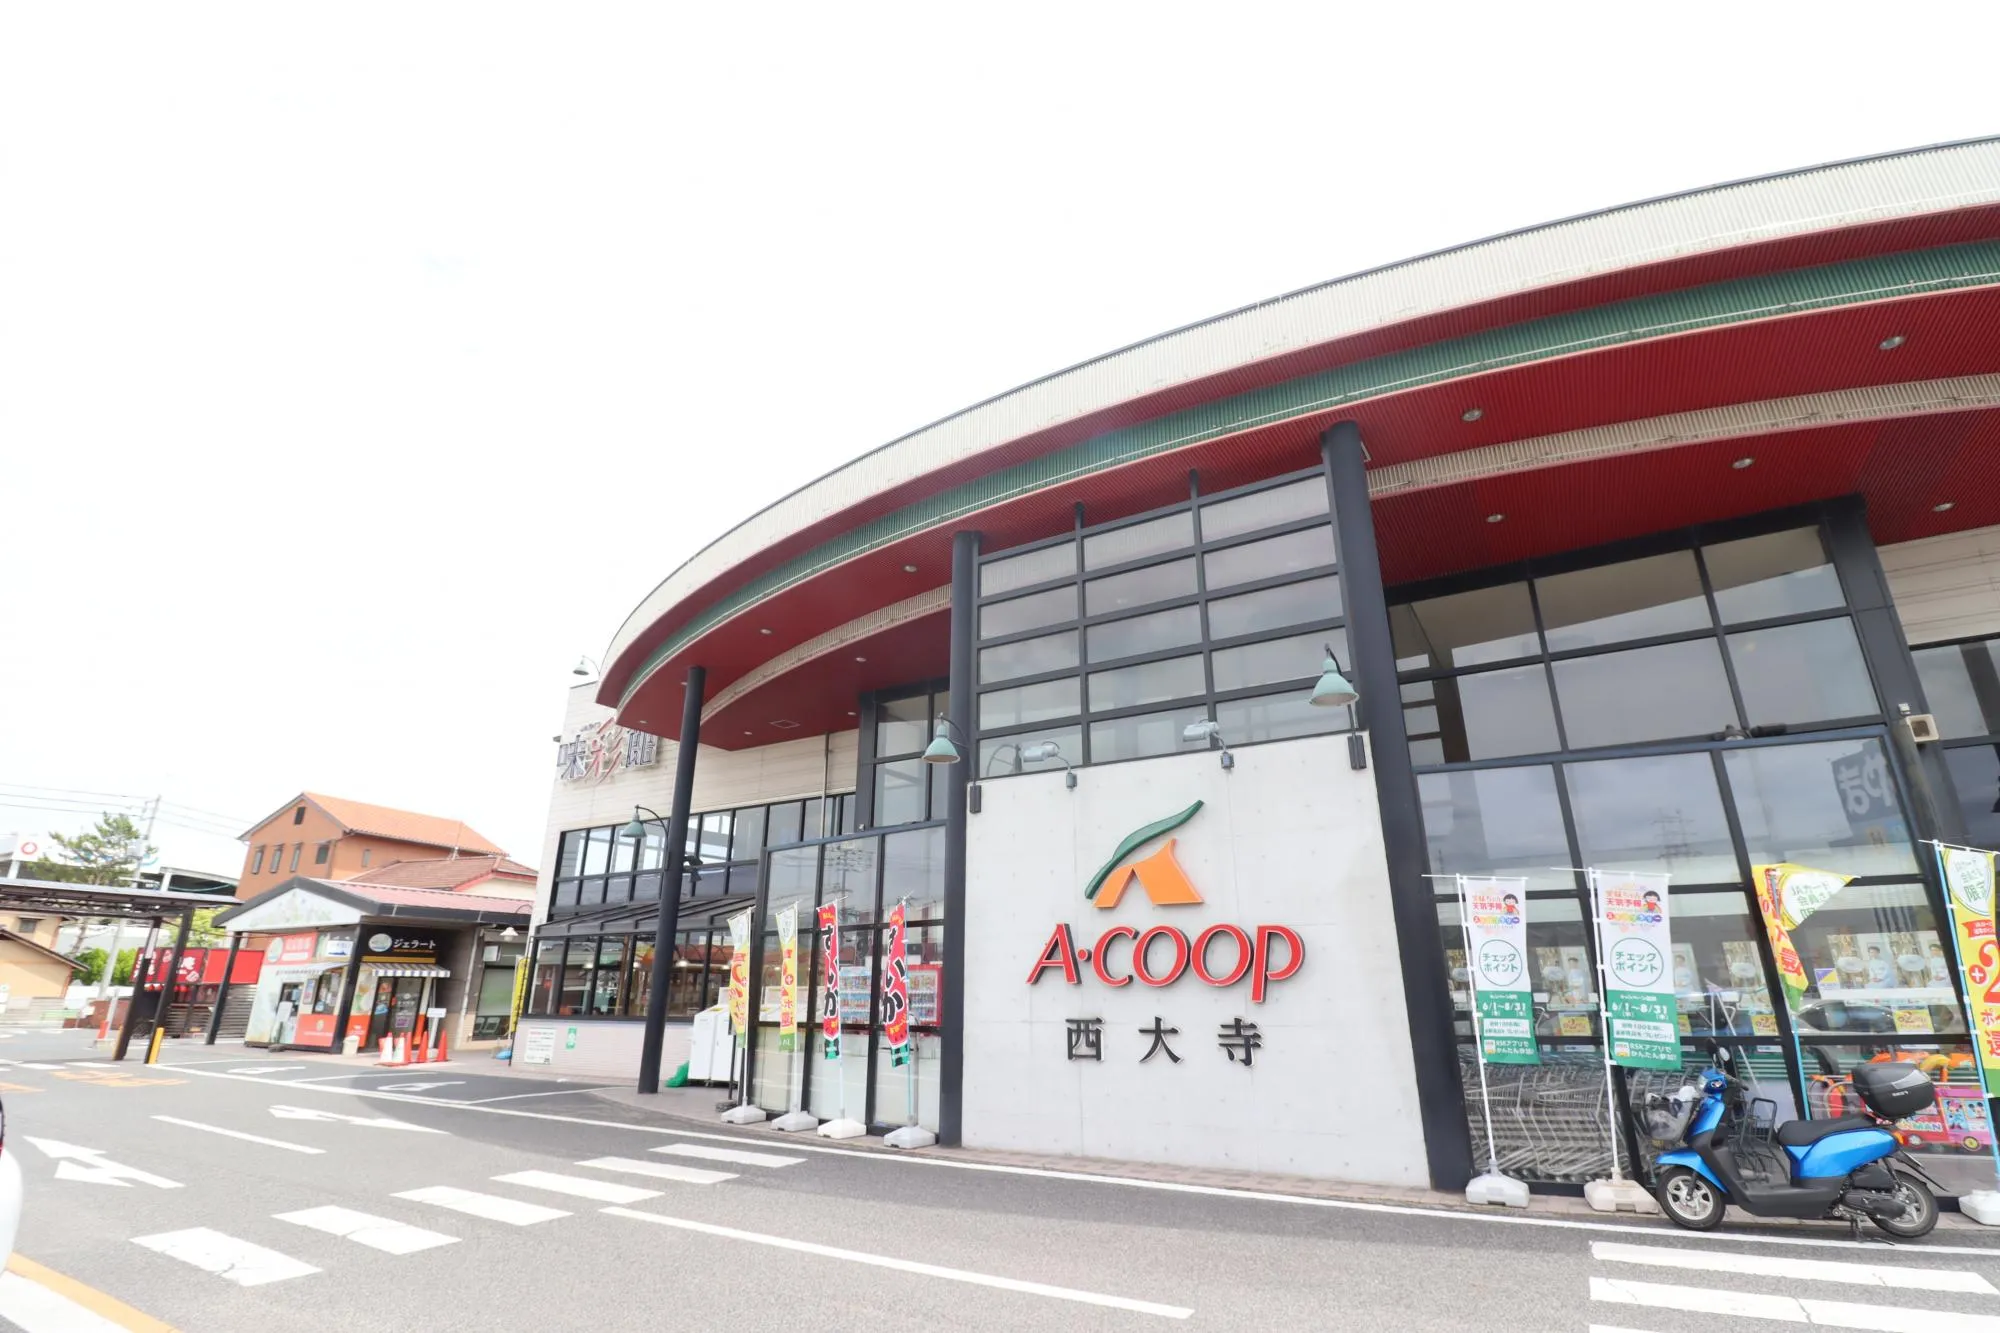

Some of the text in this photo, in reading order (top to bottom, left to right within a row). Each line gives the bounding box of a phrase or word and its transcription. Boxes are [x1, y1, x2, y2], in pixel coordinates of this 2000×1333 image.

[394, 939, 436, 949] ジェラート
[1482, 953, 1517, 962] チェック
[1616, 951, 1656, 962] チェック
[1484, 963, 1519, 973] ポイント
[1616, 962, 1658, 973] ポイント
[1065, 1015, 1264, 1066] 西大寺
